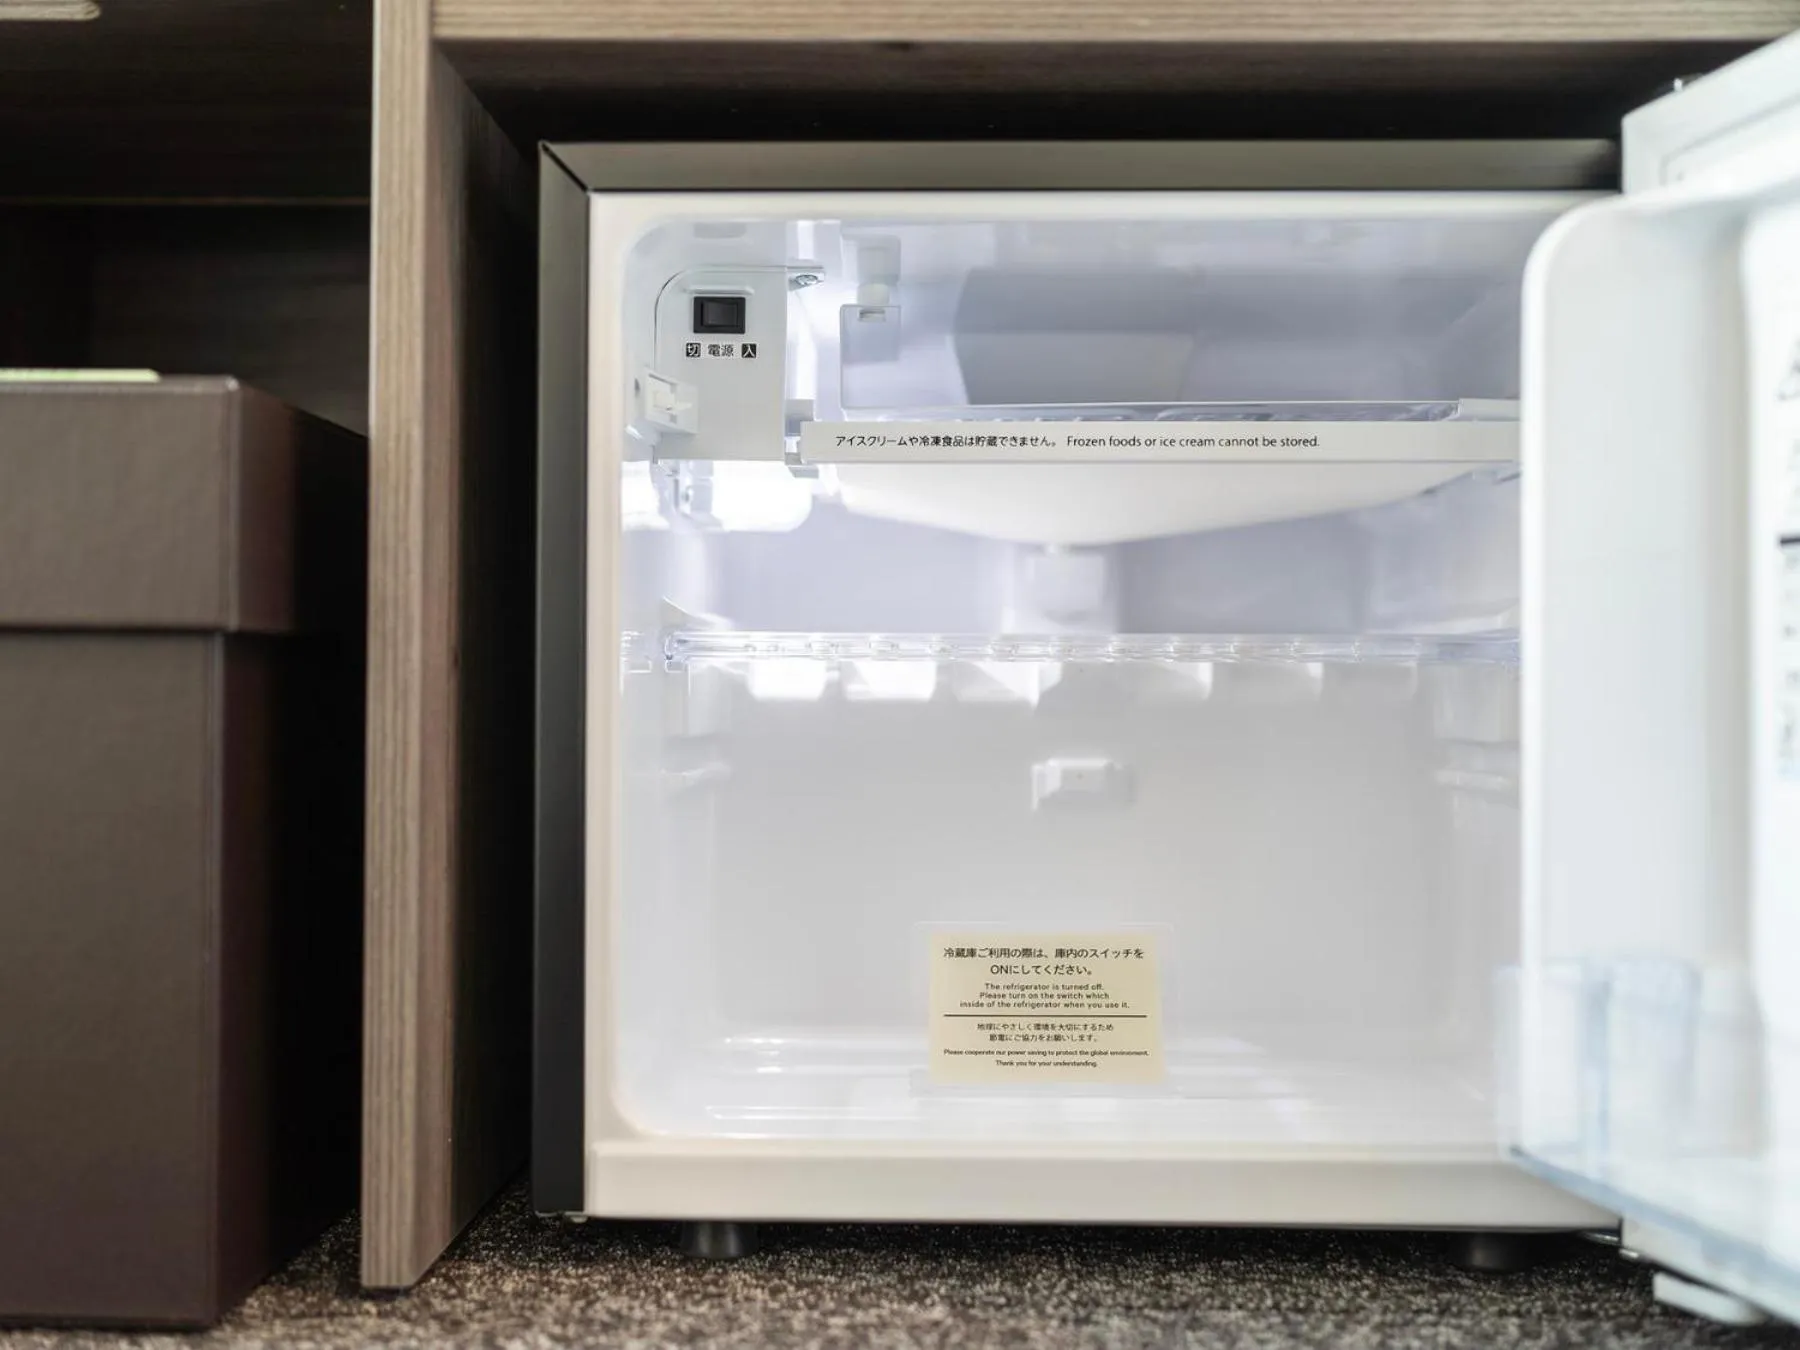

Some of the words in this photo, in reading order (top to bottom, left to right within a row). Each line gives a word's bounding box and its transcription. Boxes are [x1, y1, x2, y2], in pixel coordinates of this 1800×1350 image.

[687, 343, 701, 357] 切
[708, 344, 734, 357] 電源
[742, 343, 757, 358] 入
[835, 435, 1057, 448] アイスクリームや冷凍食品は貯蔵できません。
[1067, 435, 1106, 447] Frozen
[1109, 435, 1142, 447] foods
[1144, 438, 1157, 447] or
[1160, 436, 1176, 447] ice
[1179, 438, 1216, 447] cream
[1218, 437, 1259, 447] cannot
[1262, 435, 1277, 447] be
[1279, 435, 1320, 447] stored.
[943, 947, 1145, 960] 冷蔵庫ご利用の際は、庫内のスイッチを
[990, 963, 1093, 976] ONにしてください。
[985, 983, 1000, 991] The
[1003, 983, 1050, 991] refrigerator
[1052, 983, 1059, 991] is
[1061, 983, 1089, 991] turned
[1091, 983, 1105, 991] off.
[1013, 1001, 1061, 1009] refrigerator
[1087, 1002, 1103, 1010] you
[965, 1049, 994, 1057] cooperate
[1027, 1049, 1047, 1057] saving
[1056, 1049, 1077, 1057] protect
[1090, 1049, 1108, 1057] global
